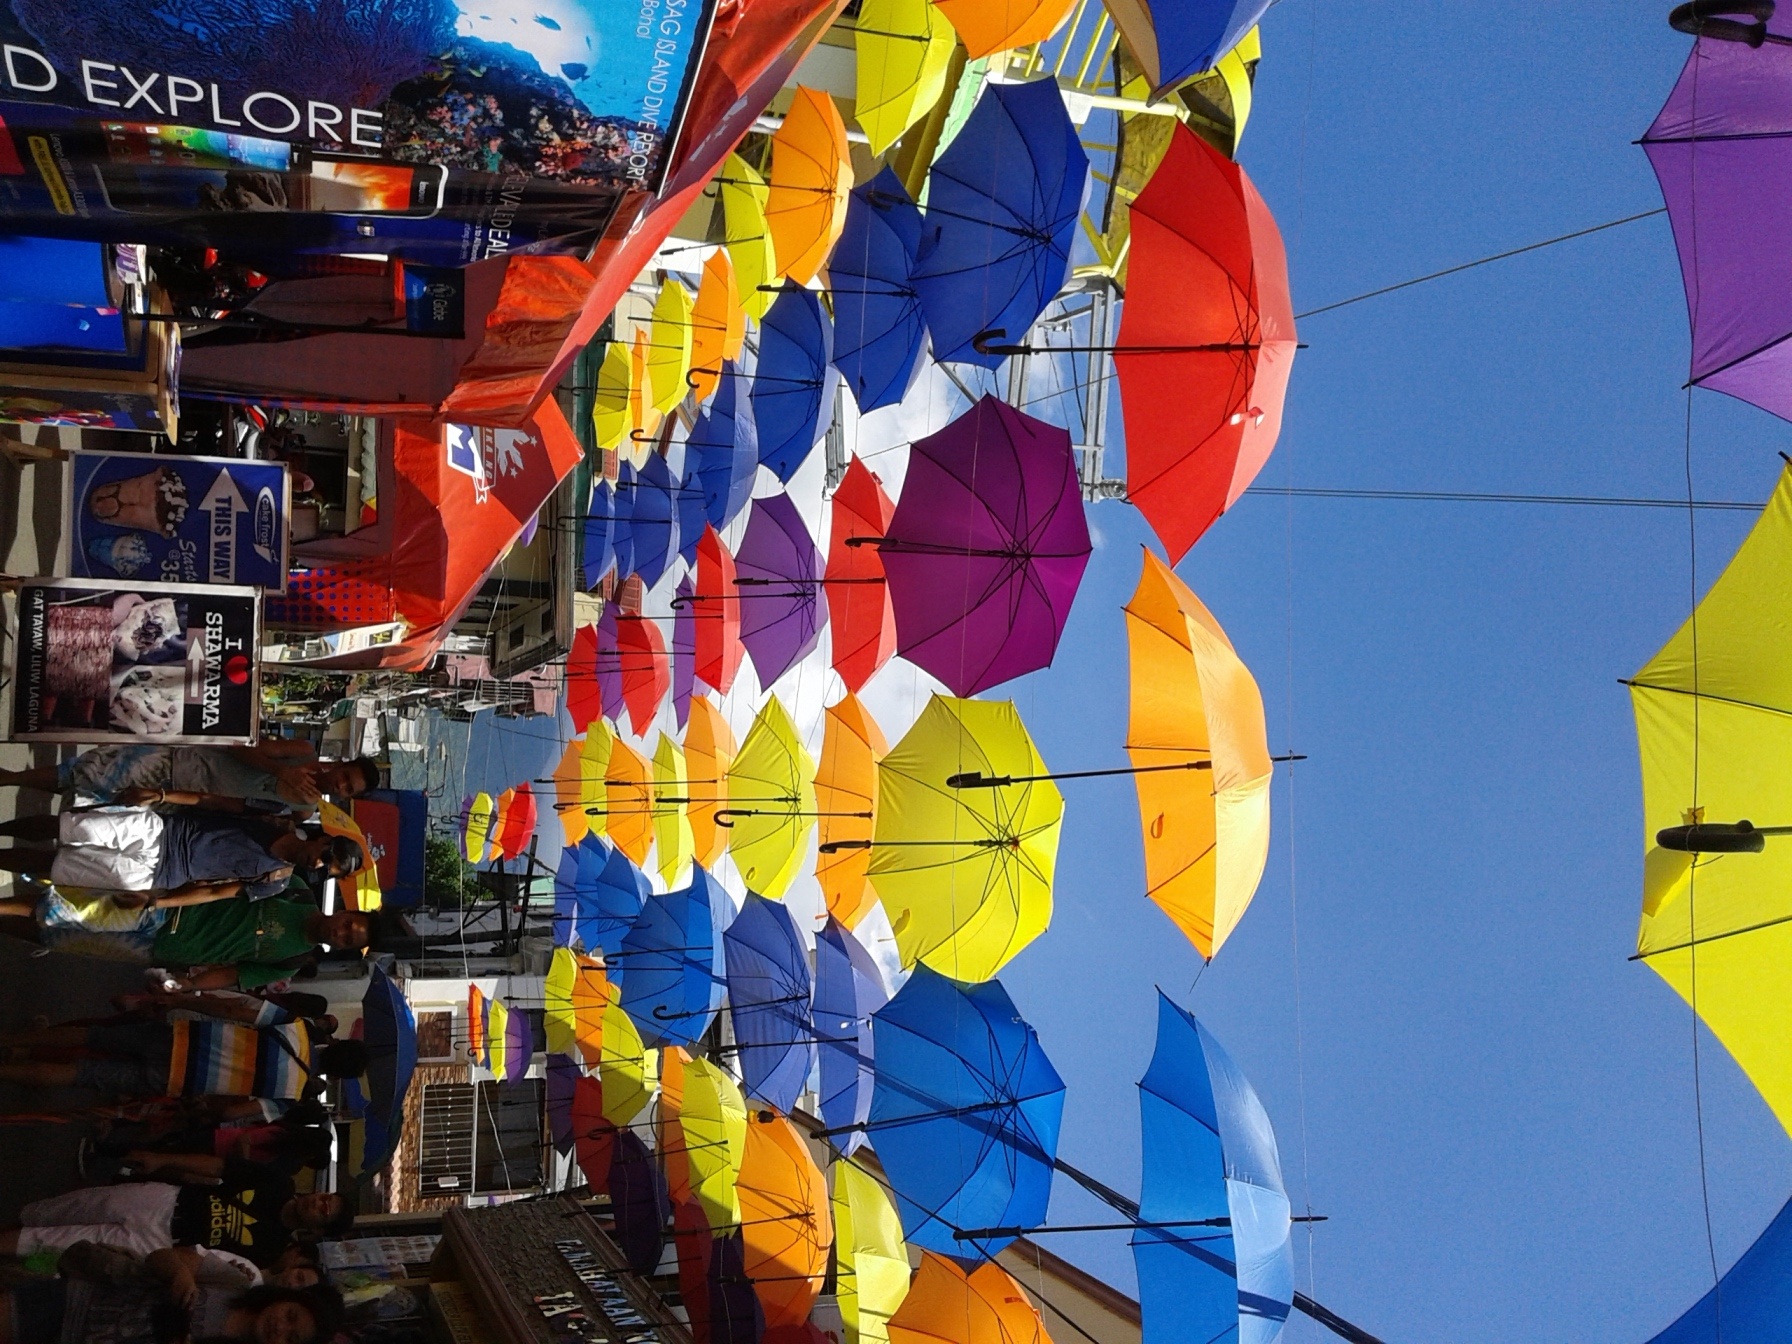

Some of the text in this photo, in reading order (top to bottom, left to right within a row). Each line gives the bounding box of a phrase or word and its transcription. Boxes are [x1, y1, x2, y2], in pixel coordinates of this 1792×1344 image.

[636, 0, 660, 39] Bohol
[2, 44, 383, 148] D EXPLORE
[625, 0, 686, 182] SAG ISLAND DIVE RESORT
[214, 496, 232, 580] THIS WAY
[261, 498, 271, 548] cake frost
[178, 538, 198, 582] Starts
[30, 614, 44, 652] TAYAW,
[224, 637, 242, 650] I
[30, 655, 42, 684] LILIW
[201, 611, 223, 730] SHAWARMA
[27, 686, 40, 732] LAGUNA
[208, 1194, 227, 1248] adidas
